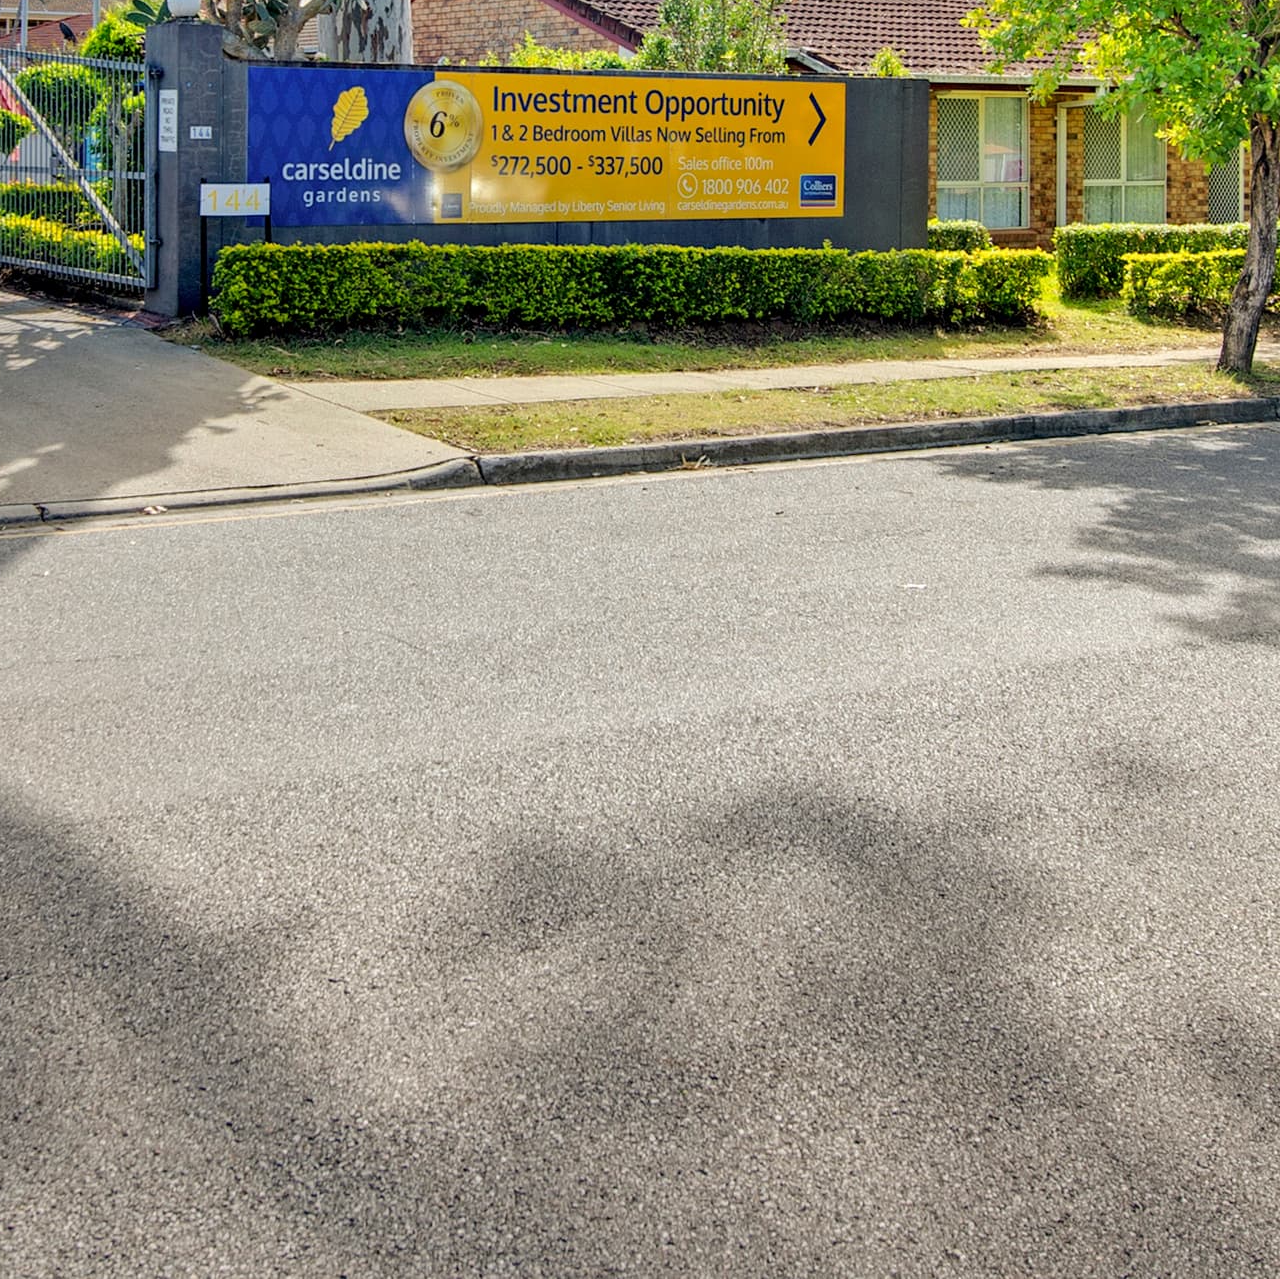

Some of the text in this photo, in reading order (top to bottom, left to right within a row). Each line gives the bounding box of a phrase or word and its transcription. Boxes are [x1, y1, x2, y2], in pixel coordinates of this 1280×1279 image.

[493, 86, 785, 123] Investment Opportunity
[192, 127, 211, 138] 144
[491, 124, 785, 148] 1 & 2 Bedroom Villas Now Selling From
[282, 158, 401, 180] carseldine
[491, 155, 571, 178] $272,500
[588, 155, 663, 178] $337,500
[678, 156, 773, 171] Sales office 100m
[702, 178, 789, 195] 1800 906 402
[803, 180, 833, 191] Colliers
[207, 188, 261, 211] 144
[303, 187, 381, 207] gardens
[677, 199, 789, 213] carseldinegardens.com.au
[470, 201, 507, 215] Proudly
[509, 201, 556, 215] Managed
[558, 200, 569, 214] by
[572, 200, 604, 214] Liberty
[606, 200, 635, 212] Senior
[639, 199, 665, 212] Living
